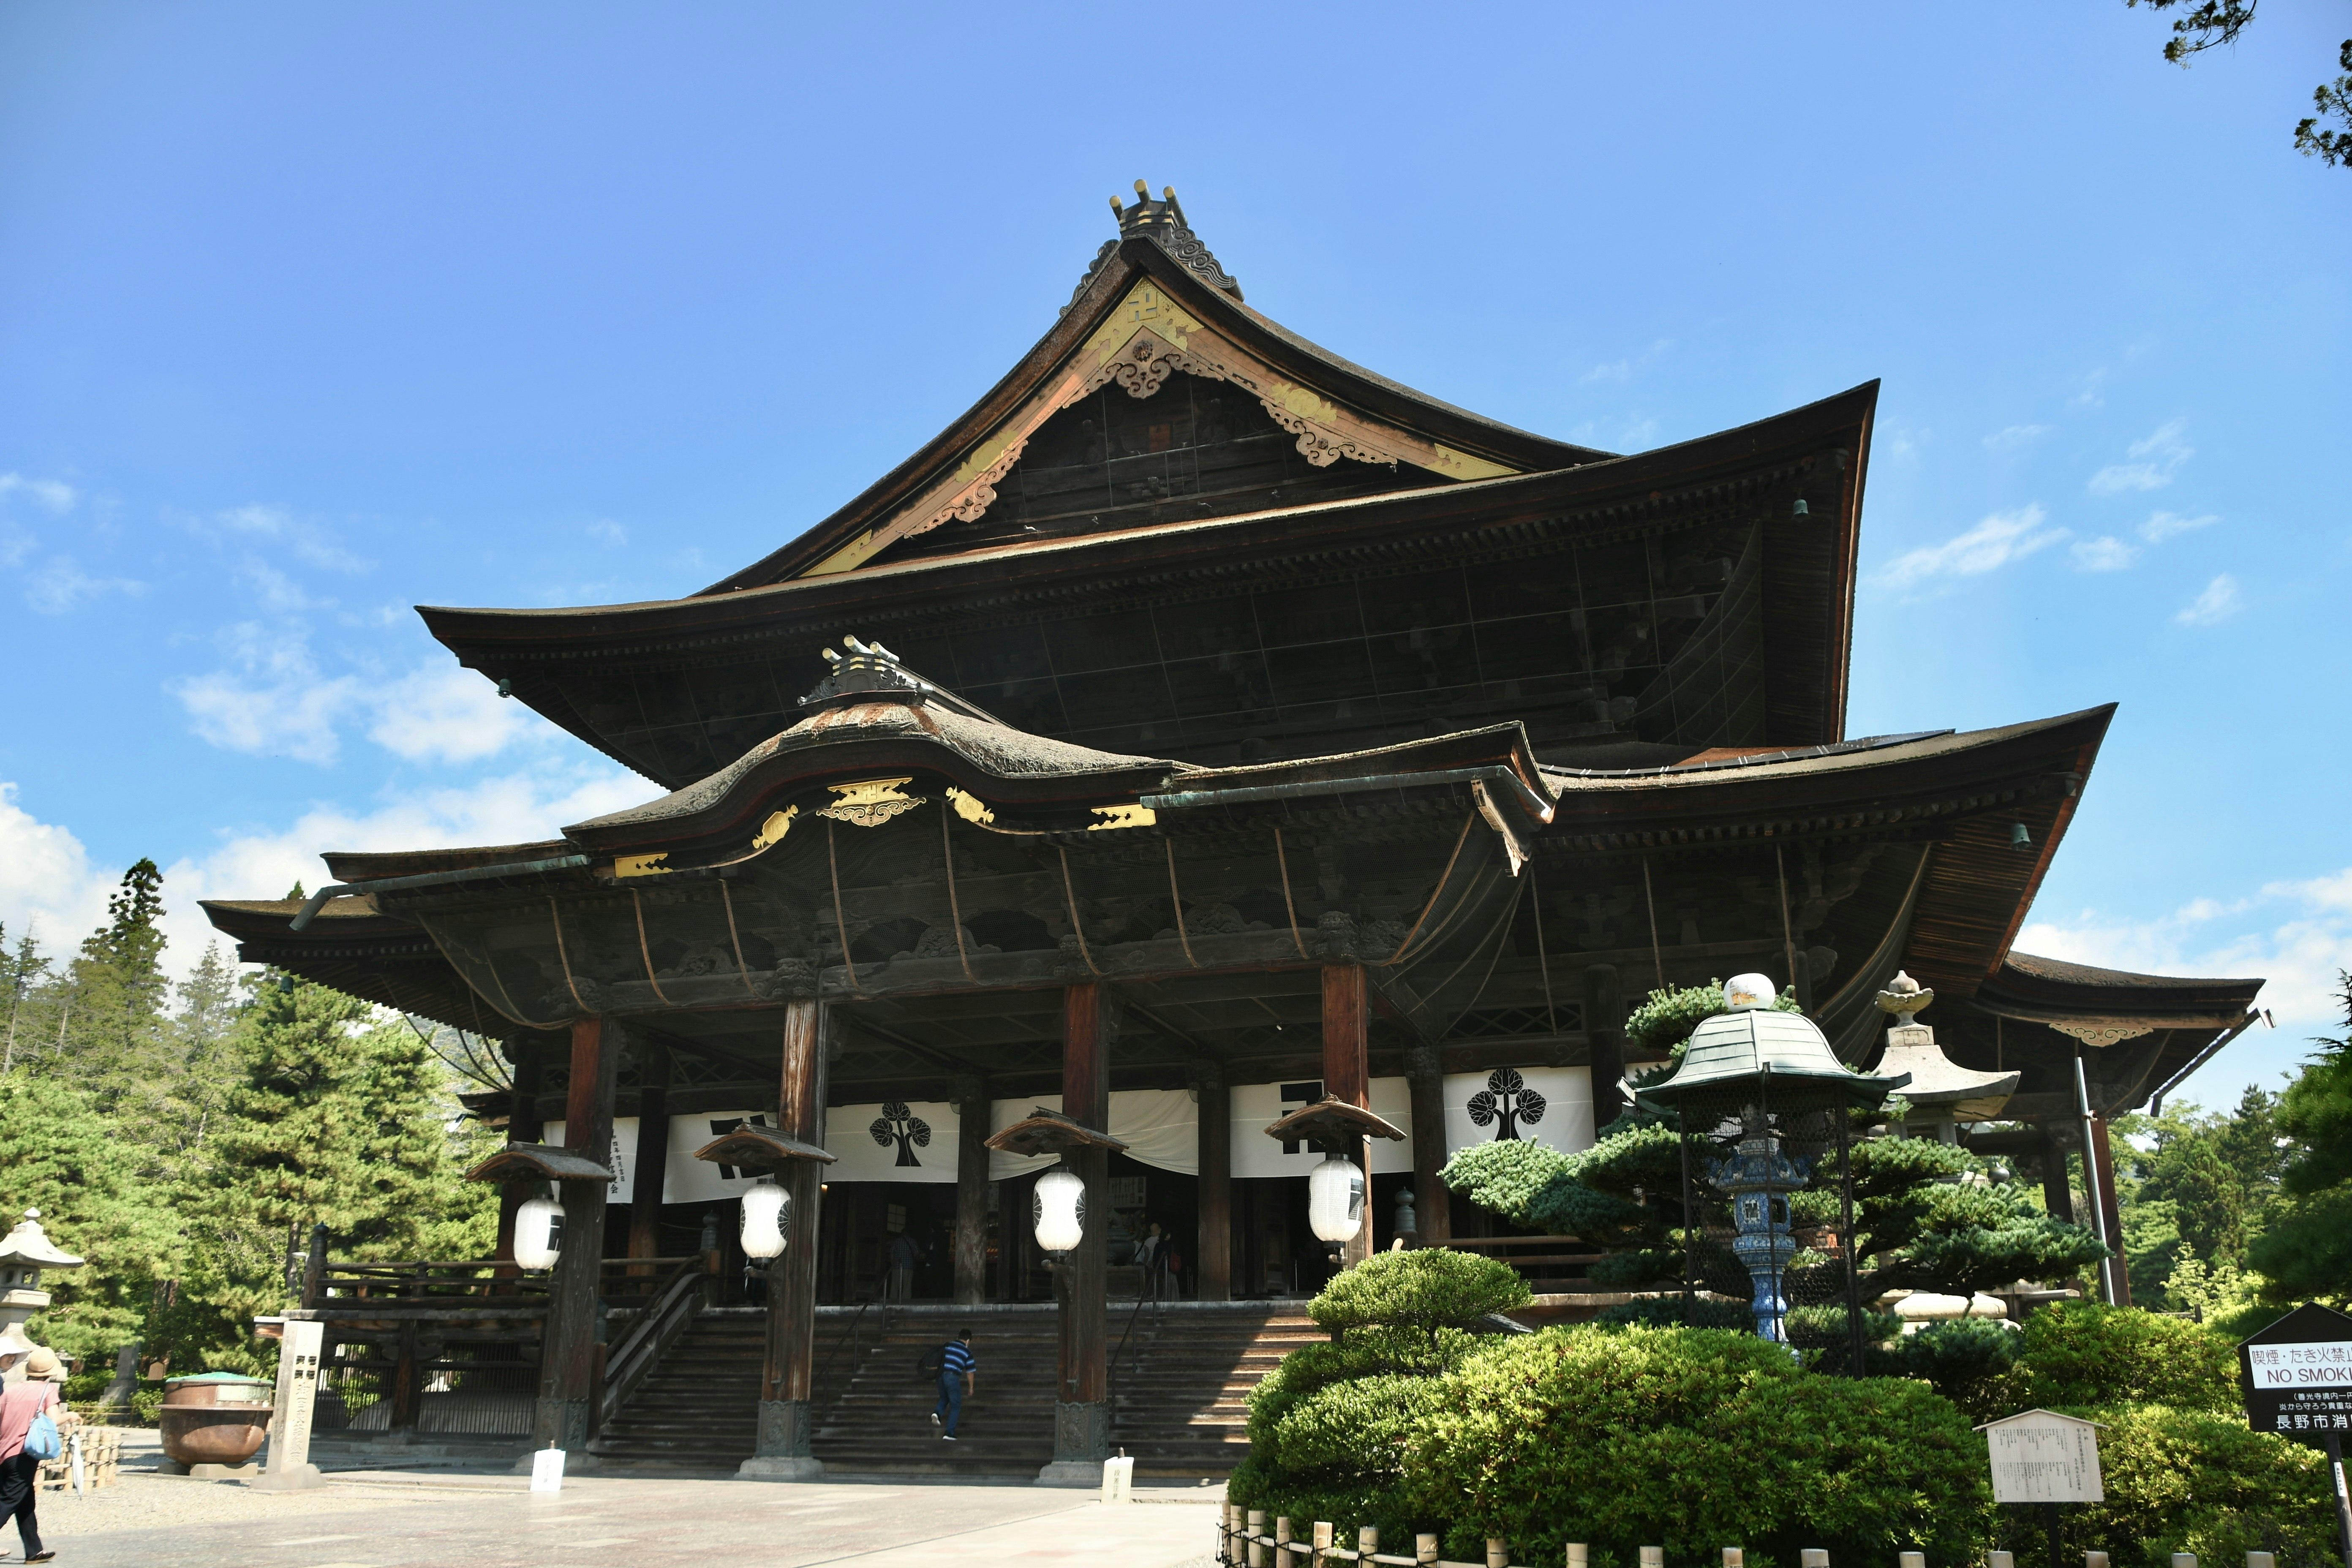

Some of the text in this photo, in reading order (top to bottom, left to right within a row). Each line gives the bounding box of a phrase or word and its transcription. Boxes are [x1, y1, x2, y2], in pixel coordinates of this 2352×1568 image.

[2267, 1367, 2352, 1383] NO SMOKI
[2276, 1413, 2352, 1429] 長野市消
